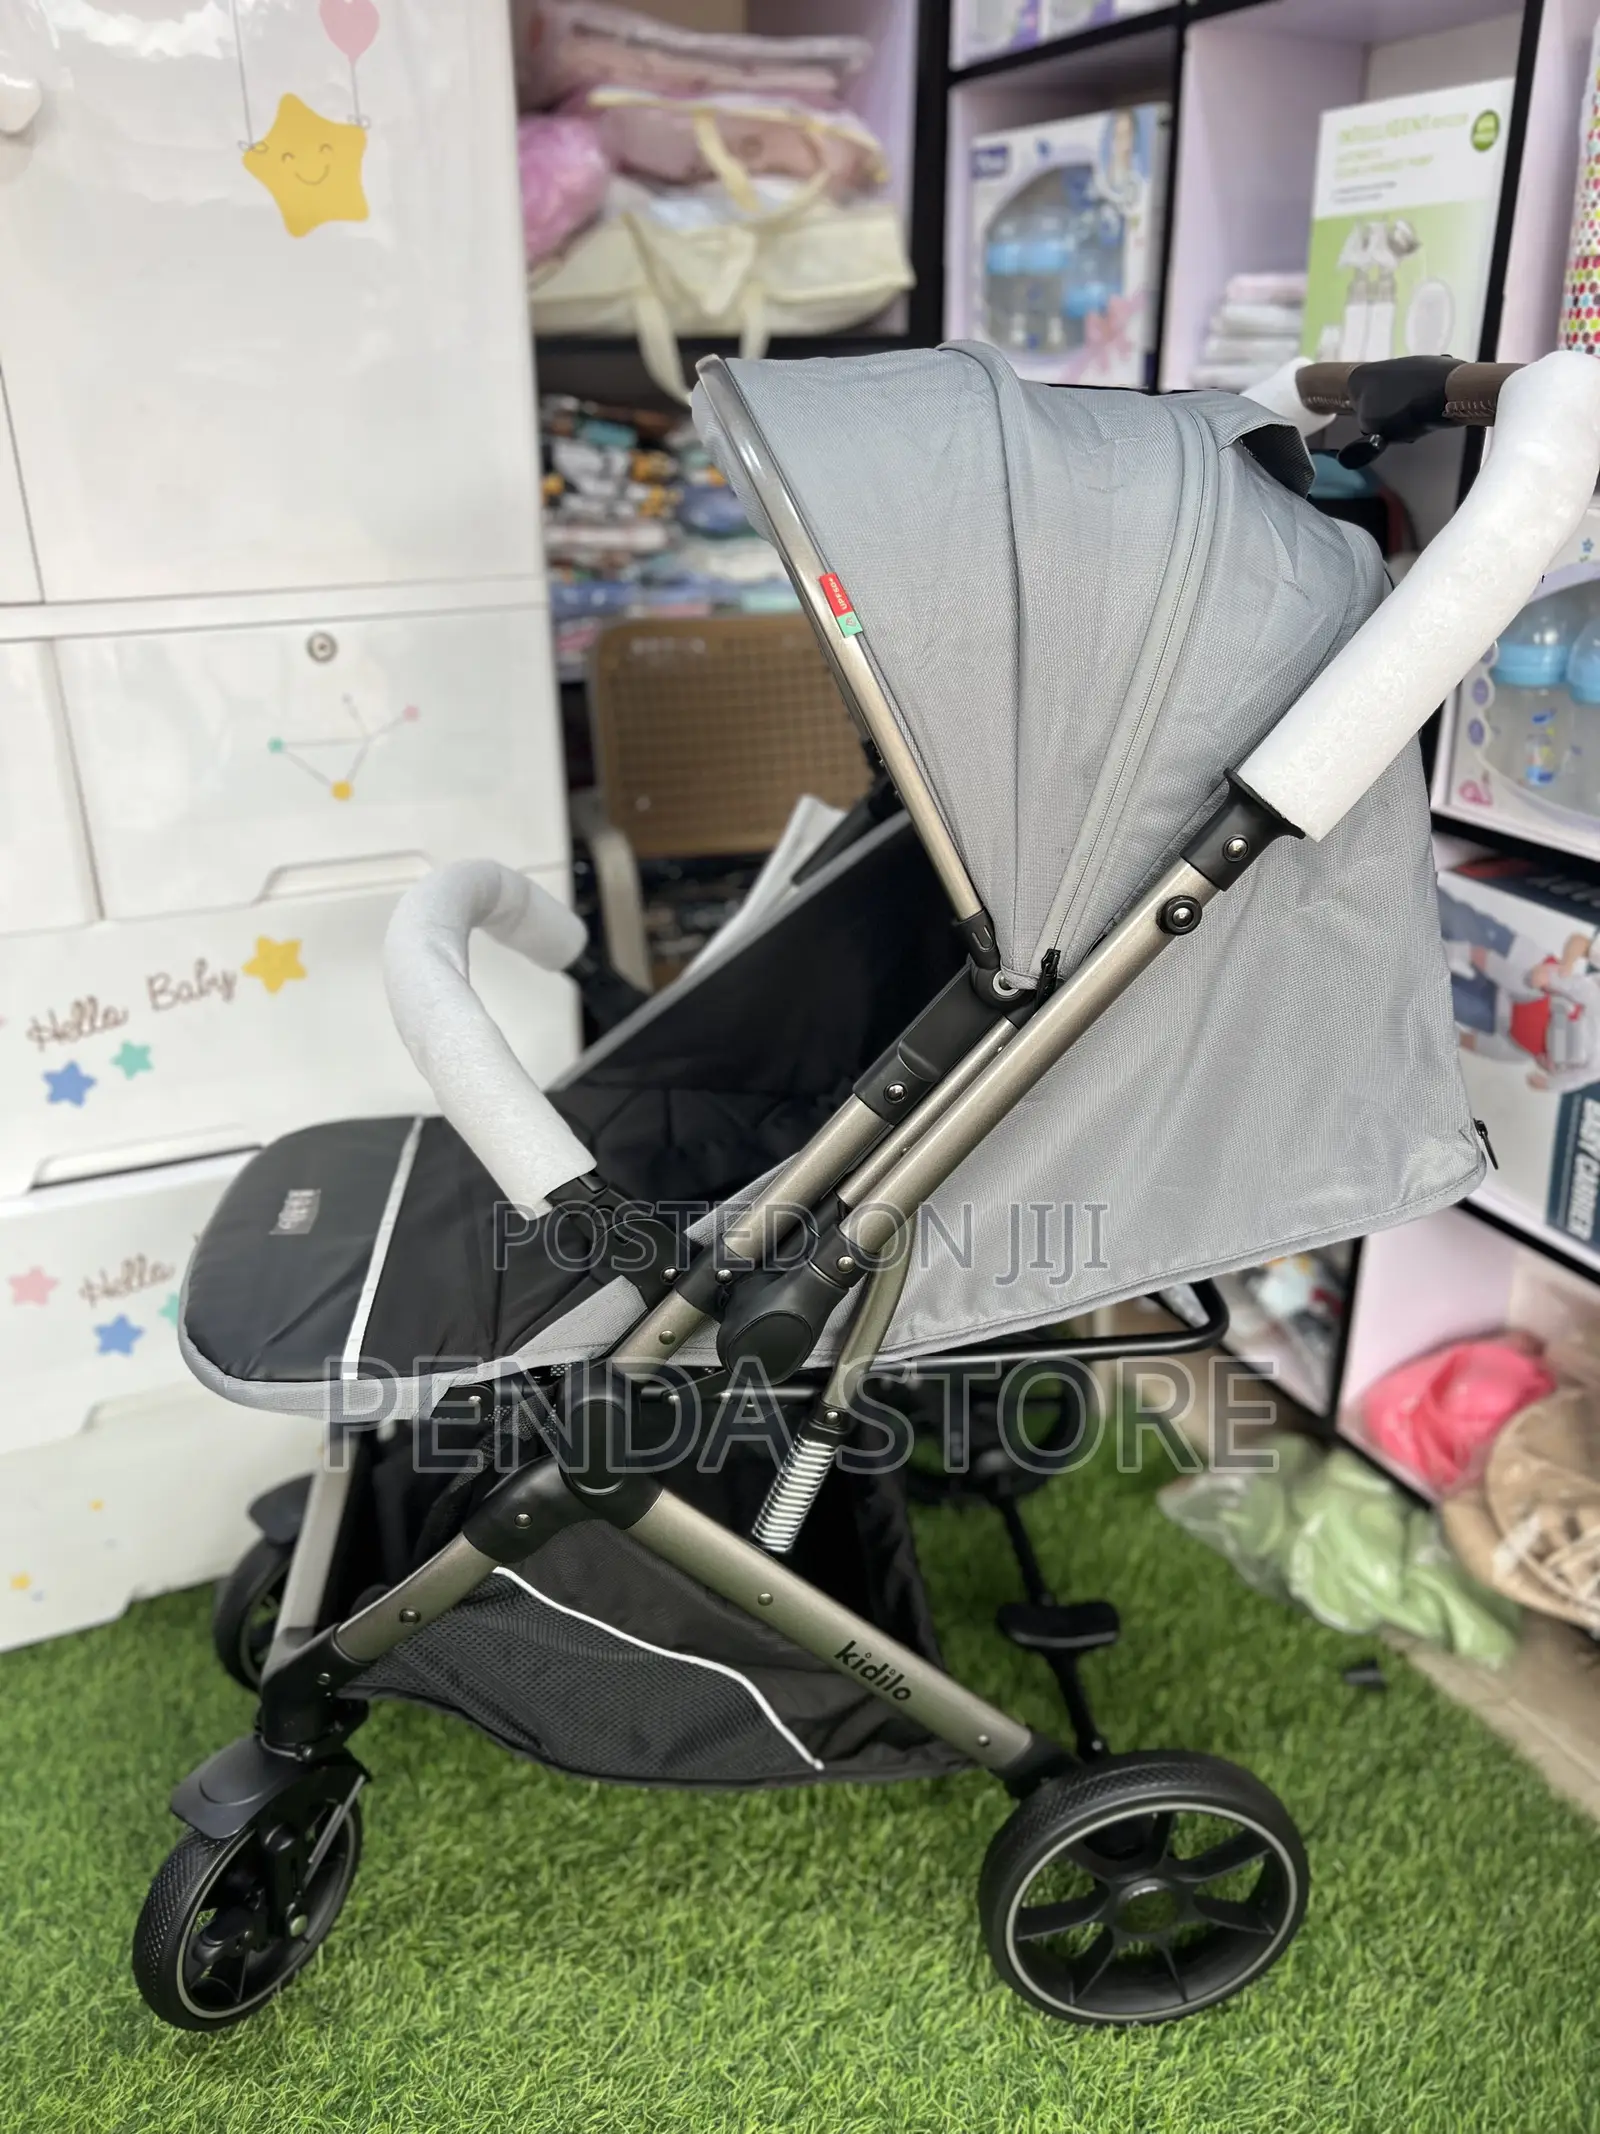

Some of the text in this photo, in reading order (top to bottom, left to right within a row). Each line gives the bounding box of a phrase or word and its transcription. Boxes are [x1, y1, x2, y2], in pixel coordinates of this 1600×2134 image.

[26, 957, 238, 1052] Hello Baby
[833, 1640, 912, 1701] kidilo
